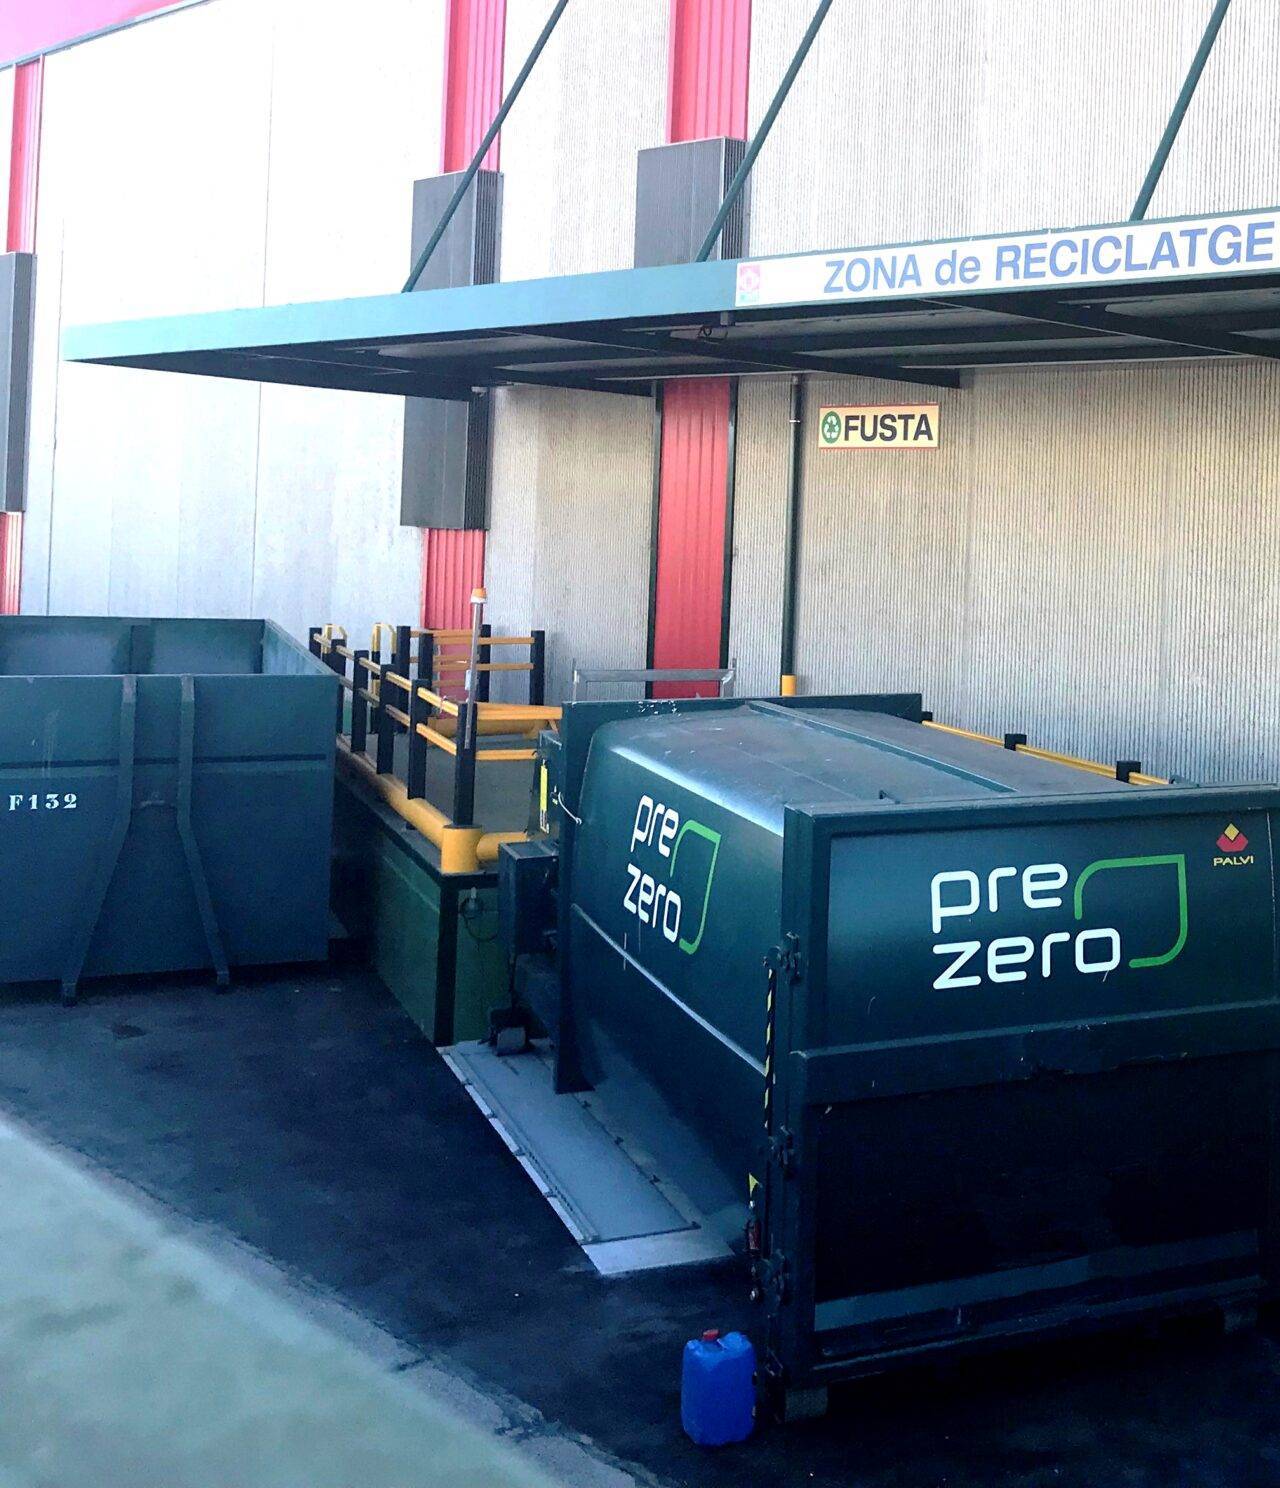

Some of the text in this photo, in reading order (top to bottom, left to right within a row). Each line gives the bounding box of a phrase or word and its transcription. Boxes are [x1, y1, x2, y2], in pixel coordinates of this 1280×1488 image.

[823, 254, 922, 294] ZONA
[935, 247, 981, 286] de
[995, 219, 1275, 282] RECICLATGE
[844, 413, 934, 443] FUSTA
[630, 794, 680, 858] pre
[1213, 855, 1254, 866] PALVI
[623, 864, 682, 944] zero
[931, 862, 1069, 934] pre
[932, 928, 1121, 989] zero
